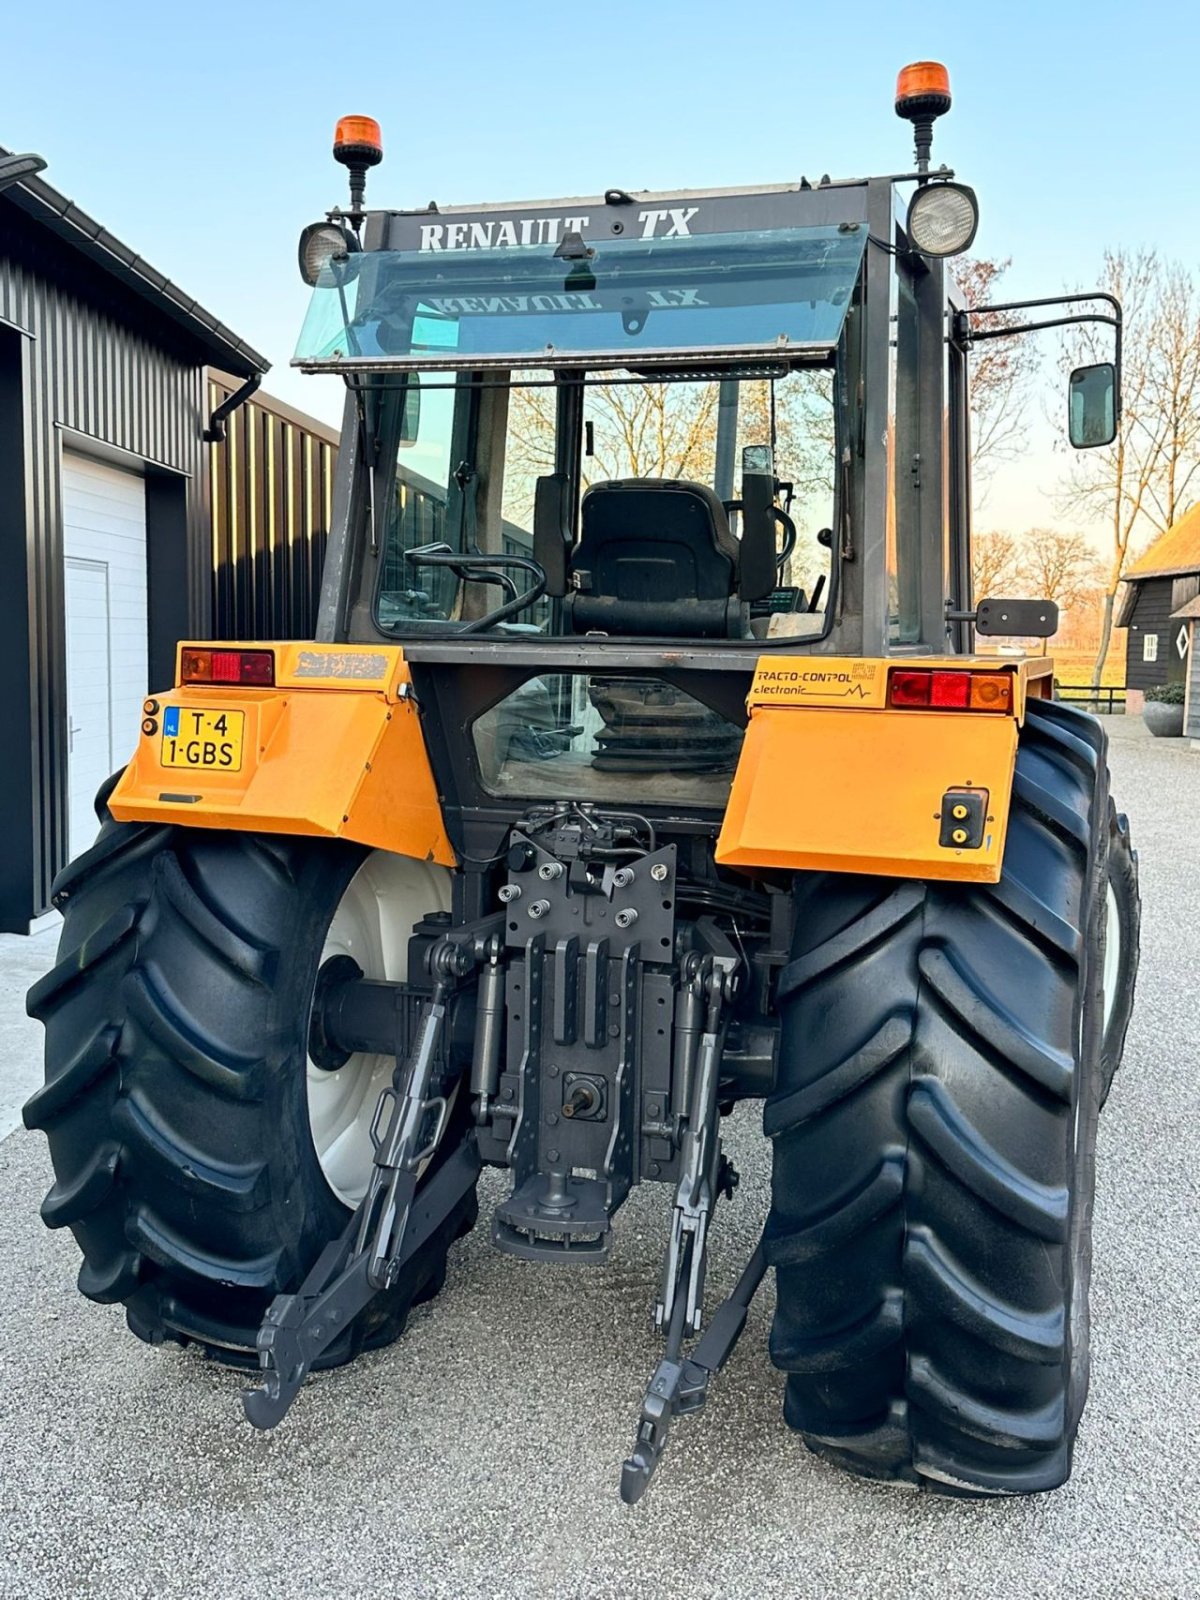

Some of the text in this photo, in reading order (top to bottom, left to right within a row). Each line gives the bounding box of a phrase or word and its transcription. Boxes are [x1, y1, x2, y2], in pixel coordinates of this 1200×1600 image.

[638, 207, 700, 242] TX
[167, 724, 177, 733] NL
[191, 712, 228, 737] T-4
[170, 740, 233, 766] 1-GBS
